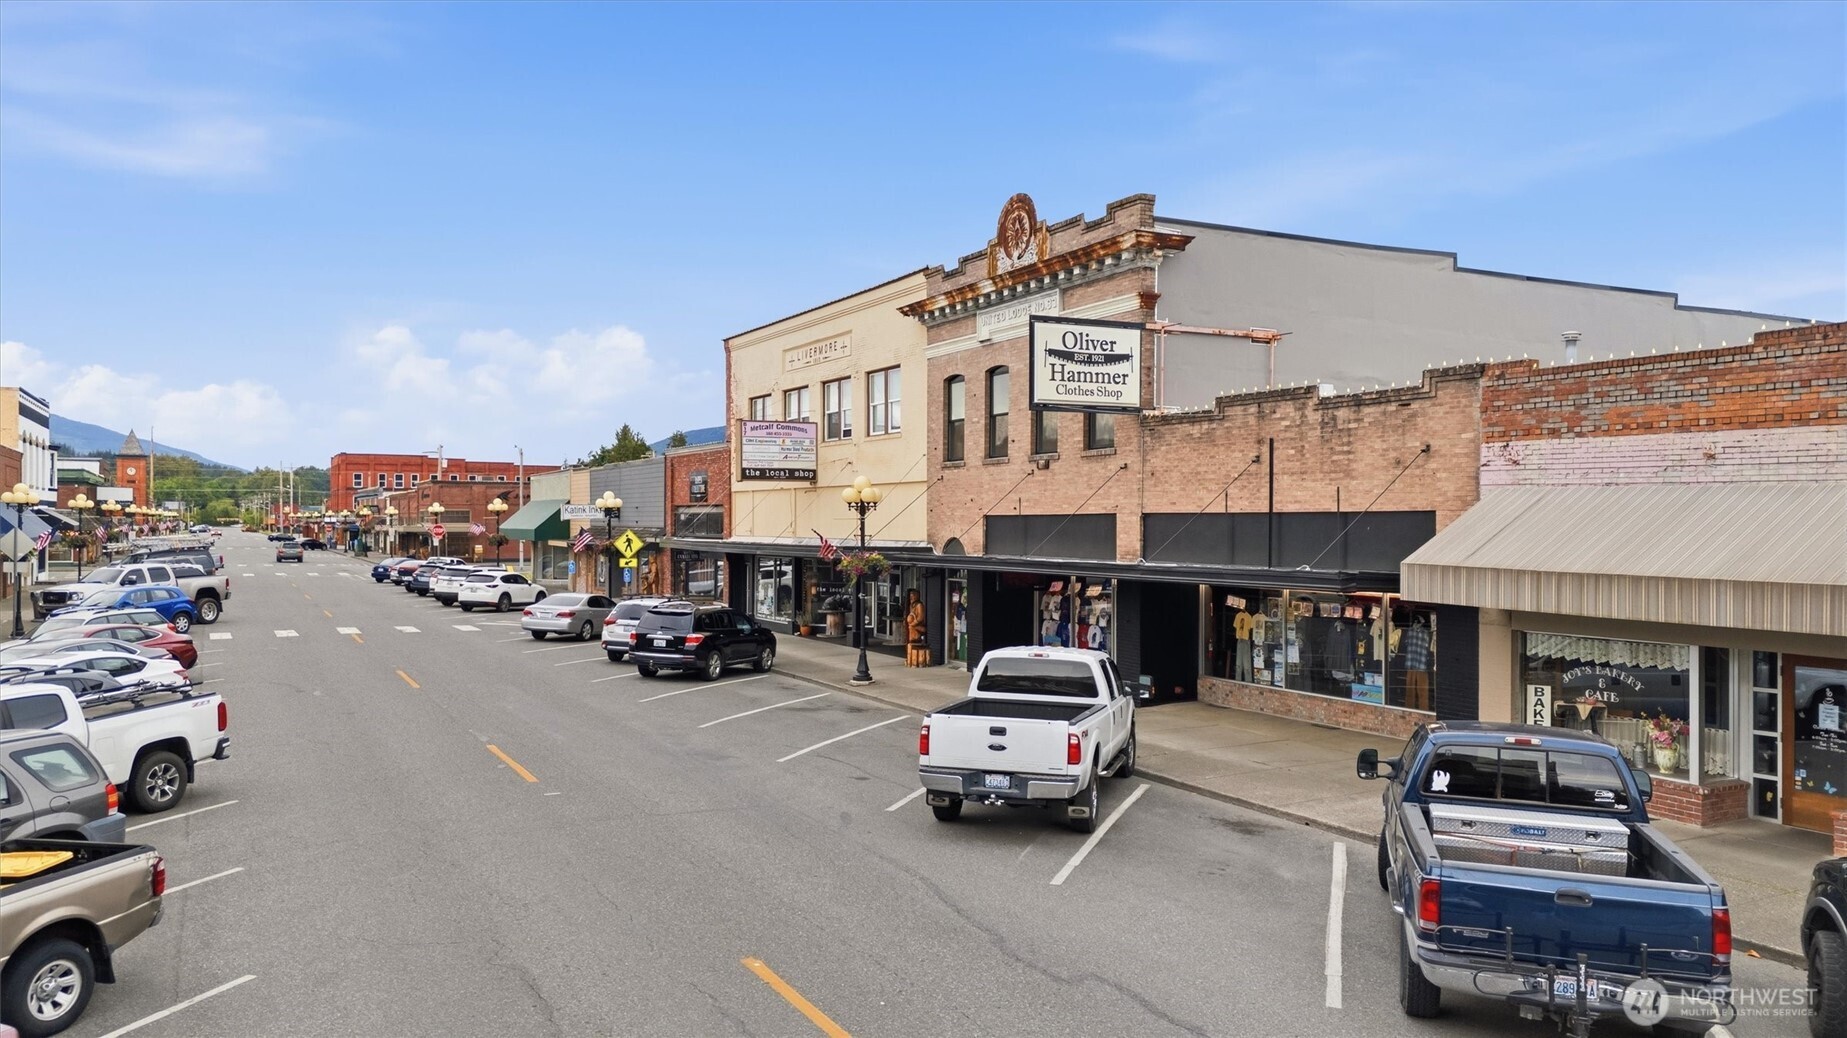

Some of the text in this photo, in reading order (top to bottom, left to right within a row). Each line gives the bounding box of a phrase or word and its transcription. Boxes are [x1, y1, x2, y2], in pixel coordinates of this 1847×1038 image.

[981, 312, 1006, 327] UNITED
[1008, 305, 1032, 320] LODGE
[1061, 331, 1117, 352] Oliver
[797, 341, 837, 361] LIVERMORE
[1074, 353, 1105, 362] EST. 1921
[1049, 363, 1129, 385] Hammer
[1055, 383, 1123, 400] Clothes Shop
[750, 424, 774, 432] Metcalf
[776, 424, 808, 434] Commons
[766, 469, 789, 477] local
[795, 470, 814, 478] shop
[1562, 665, 1645, 692] JOY'S BAKERY
[1598, 678, 1606, 688] &
[1585, 689, 1619, 703] CAFE
